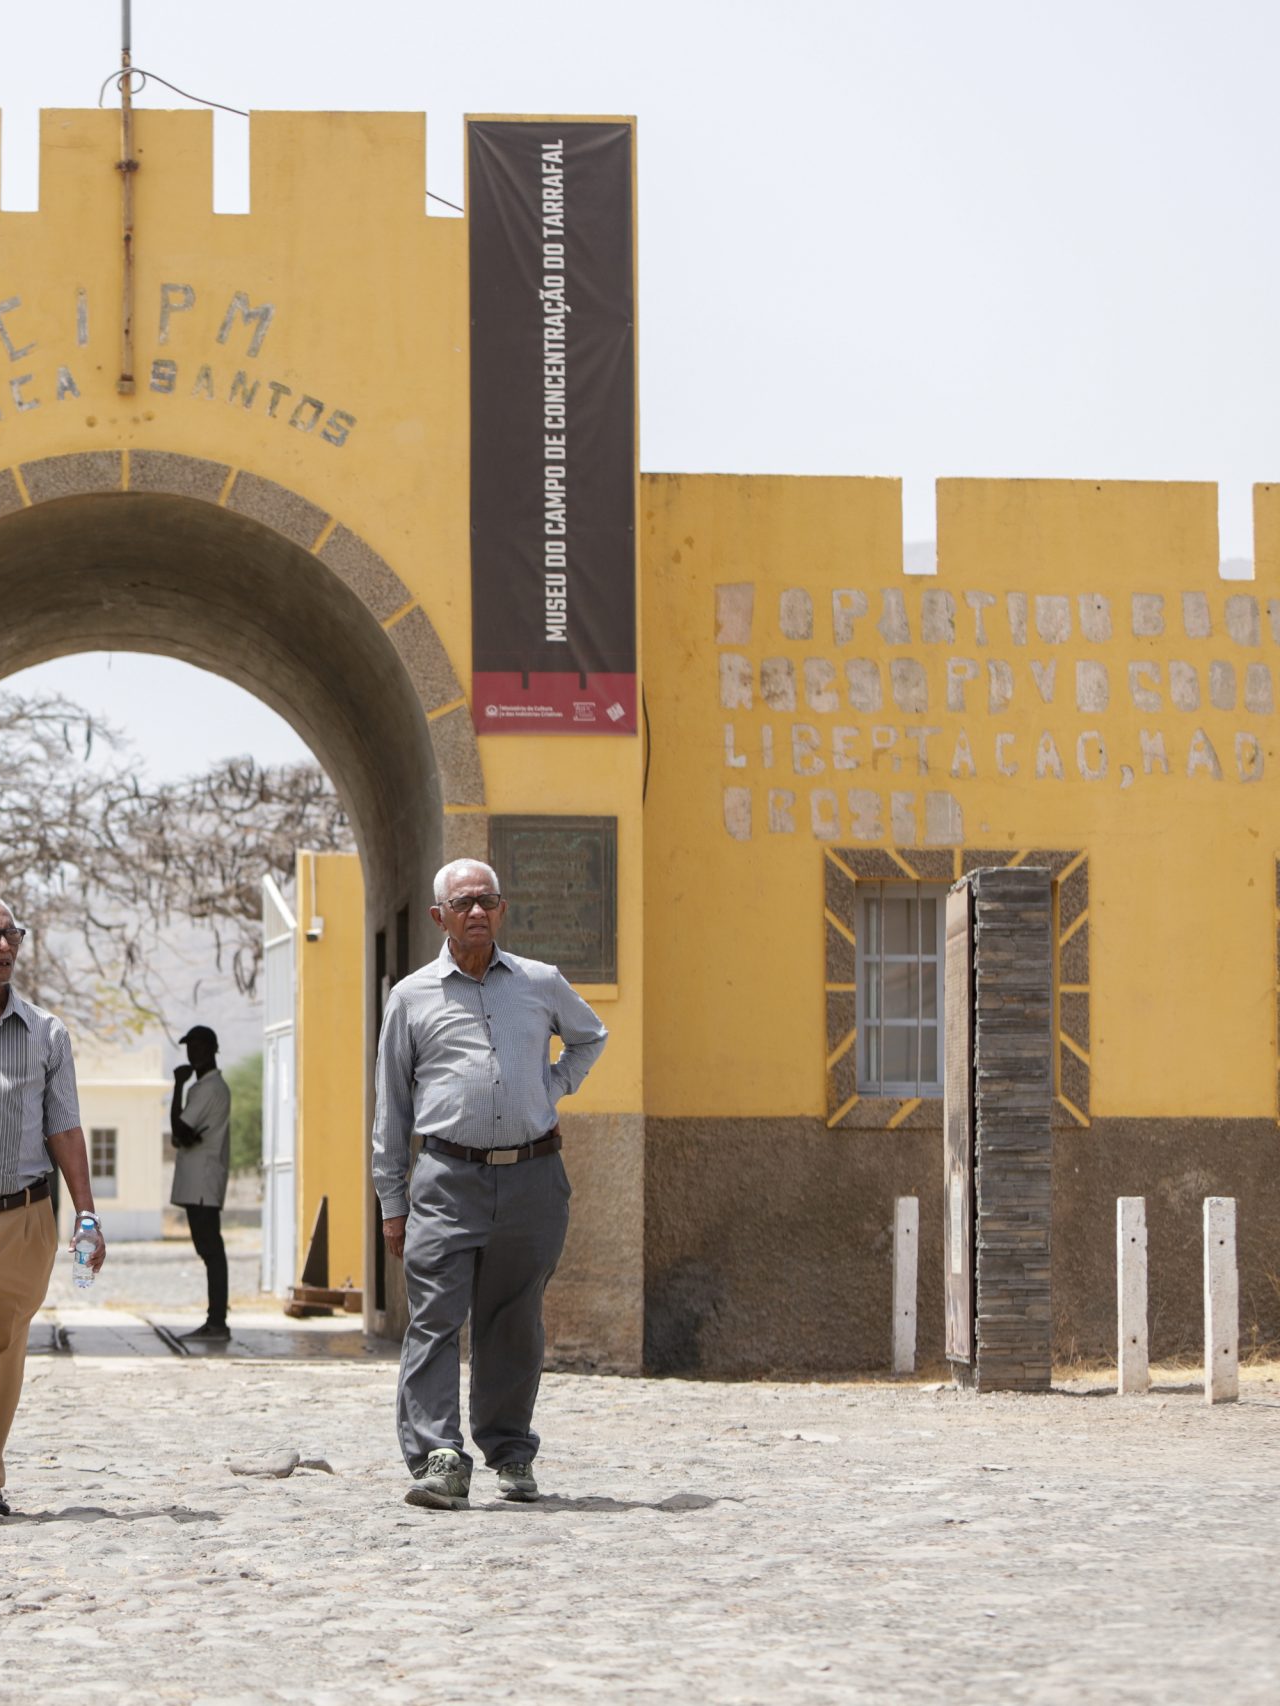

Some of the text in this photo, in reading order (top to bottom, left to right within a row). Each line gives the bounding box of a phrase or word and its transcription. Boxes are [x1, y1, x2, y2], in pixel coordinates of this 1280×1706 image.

[149, 359, 356, 447] SANTOS
[538, 139, 572, 642] MUSEU DO CAMPO DE CONCENTRAÇÃO DO TARRAFAL
